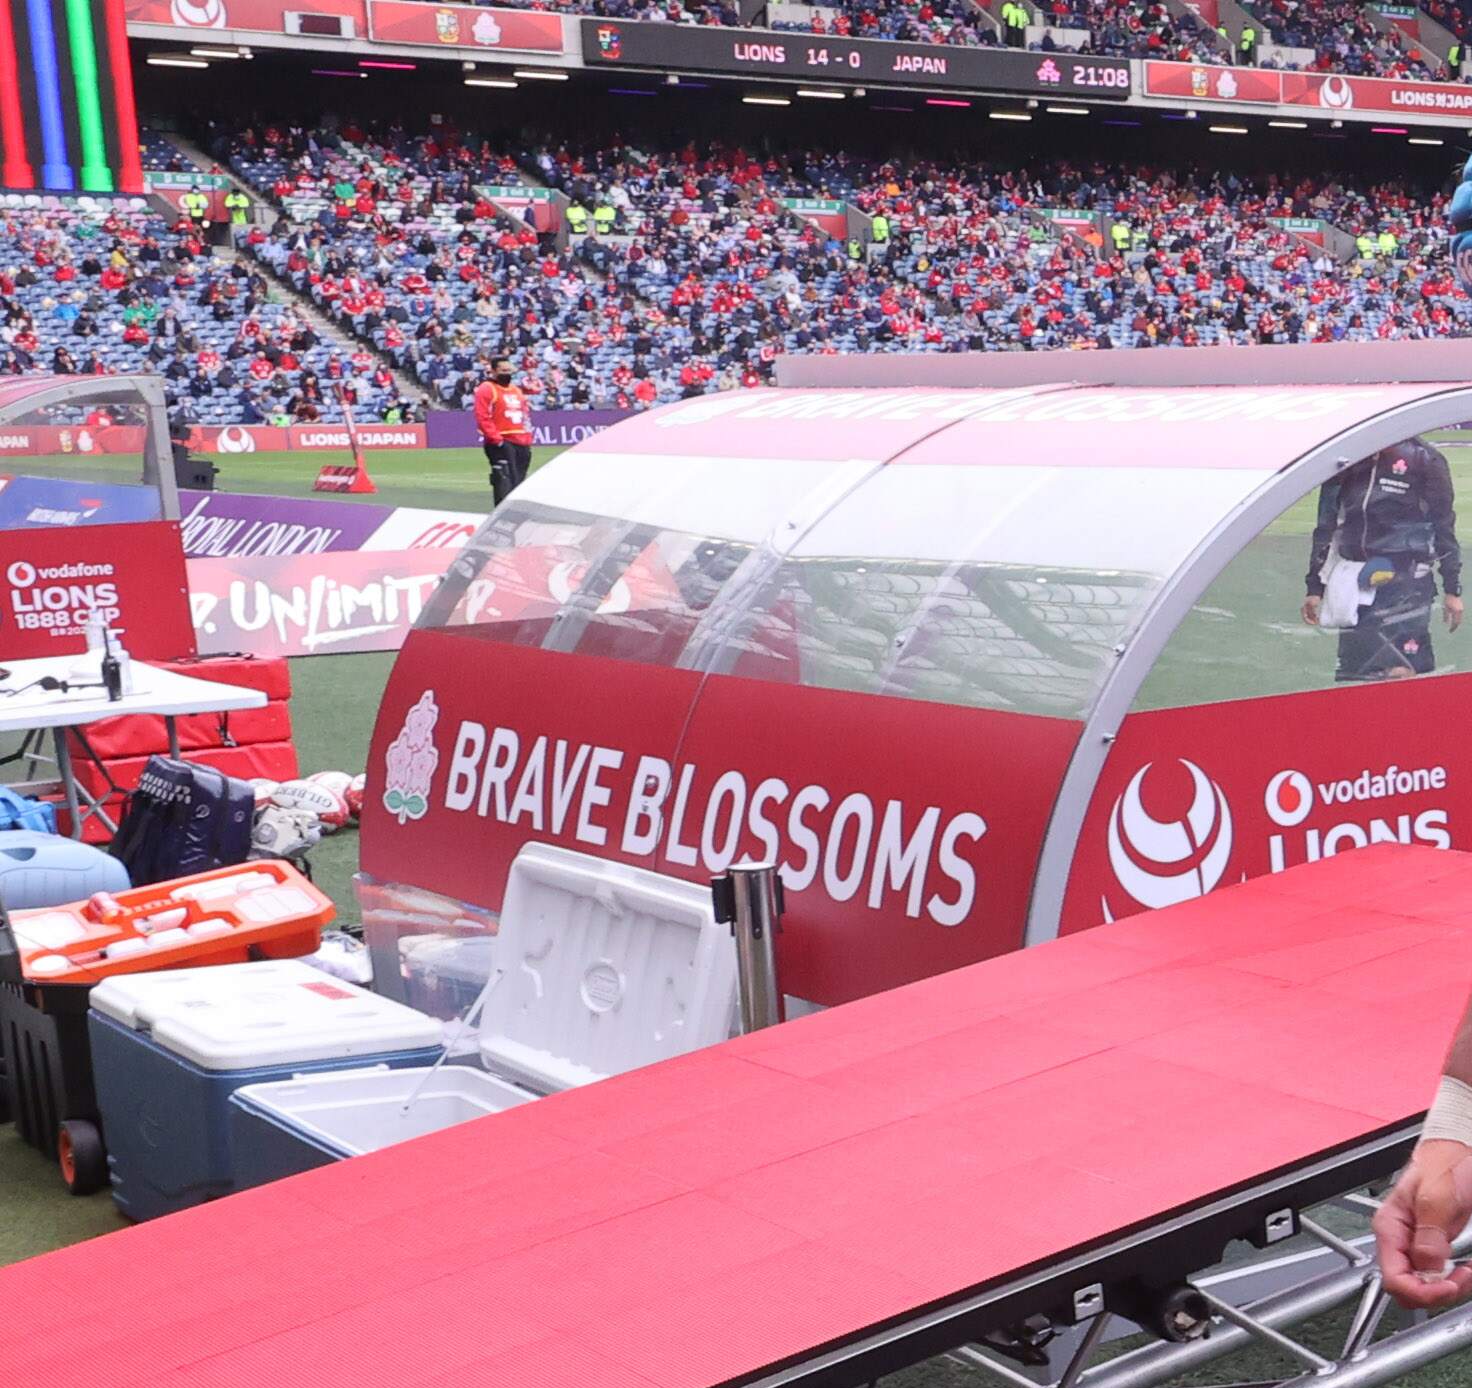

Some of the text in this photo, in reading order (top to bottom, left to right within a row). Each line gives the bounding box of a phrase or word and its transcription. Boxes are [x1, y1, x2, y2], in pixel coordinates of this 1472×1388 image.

[734, 43, 786, 63] LIONS
[807, 49, 829, 66] 14
[849, 51, 861, 68] 0
[892, 55, 946, 74] JAPAN
[1072, 65, 1129, 88] 21:08
[1391, 89, 1434, 106] LIONS
[300, 433, 416, 446] LIONS JAPAN
[37, 563, 114, 579] vodafone
[11, 582, 119, 612] LIONS
[14, 609, 71, 630] 1888
[1318, 765, 1447, 805] vodafone
[444, 719, 989, 928] BRAVE BLOSSOMS
